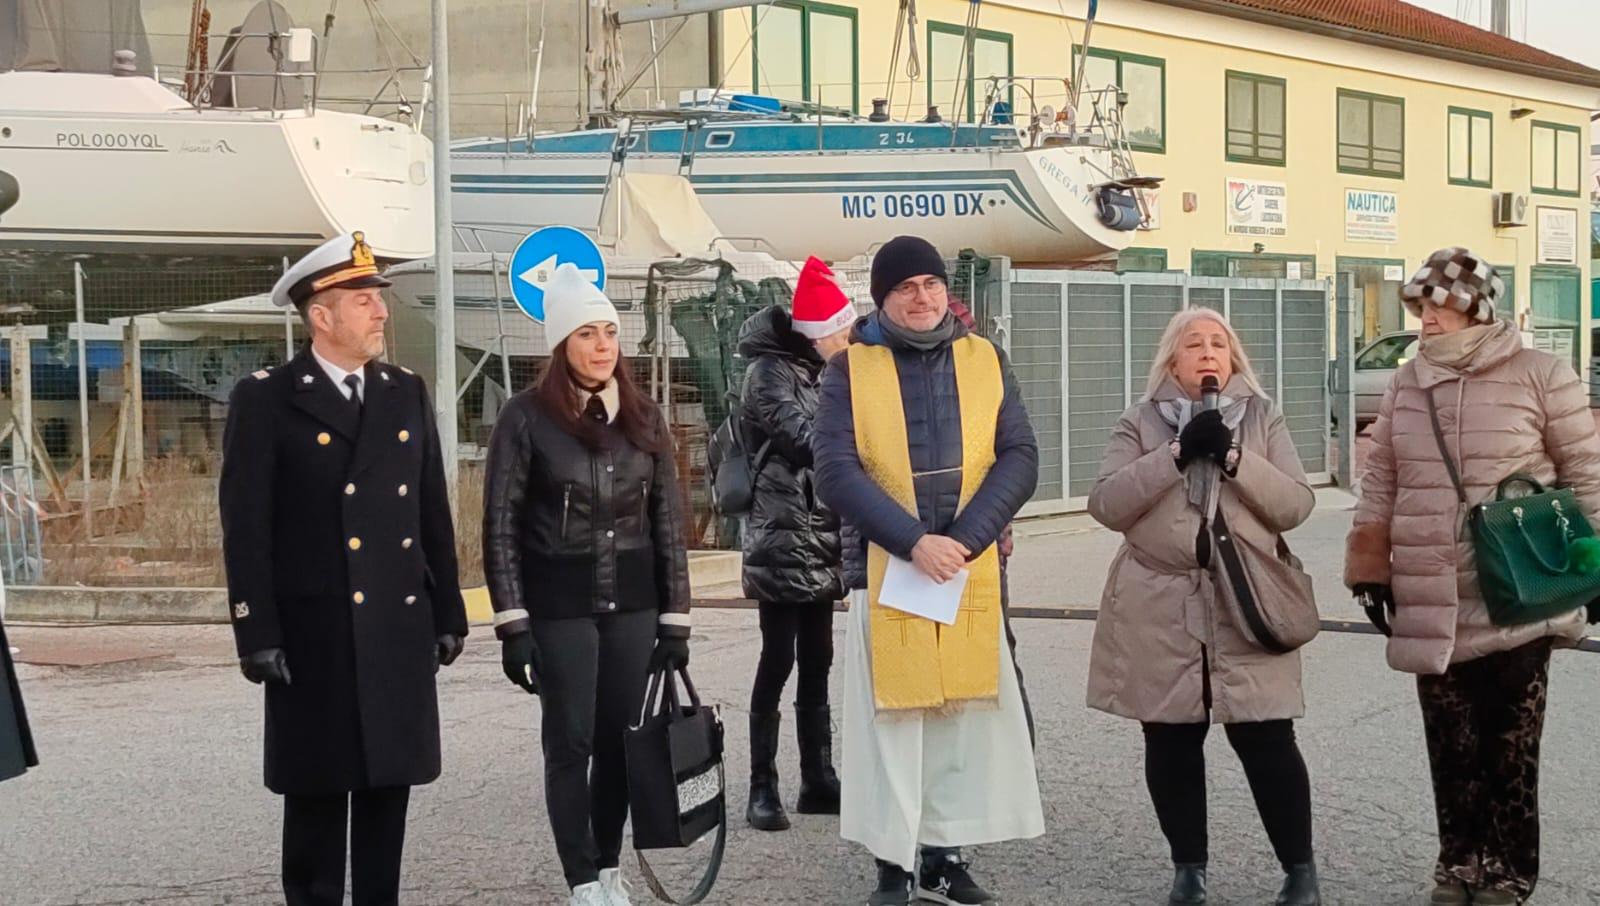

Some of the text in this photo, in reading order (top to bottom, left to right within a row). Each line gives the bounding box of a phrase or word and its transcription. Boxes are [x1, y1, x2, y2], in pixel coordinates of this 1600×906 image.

[1039, 156, 1079, 196] GREGA
[842, 192, 985, 218] MC 0690 DX
[1347, 191, 1396, 214] NAUTICA
